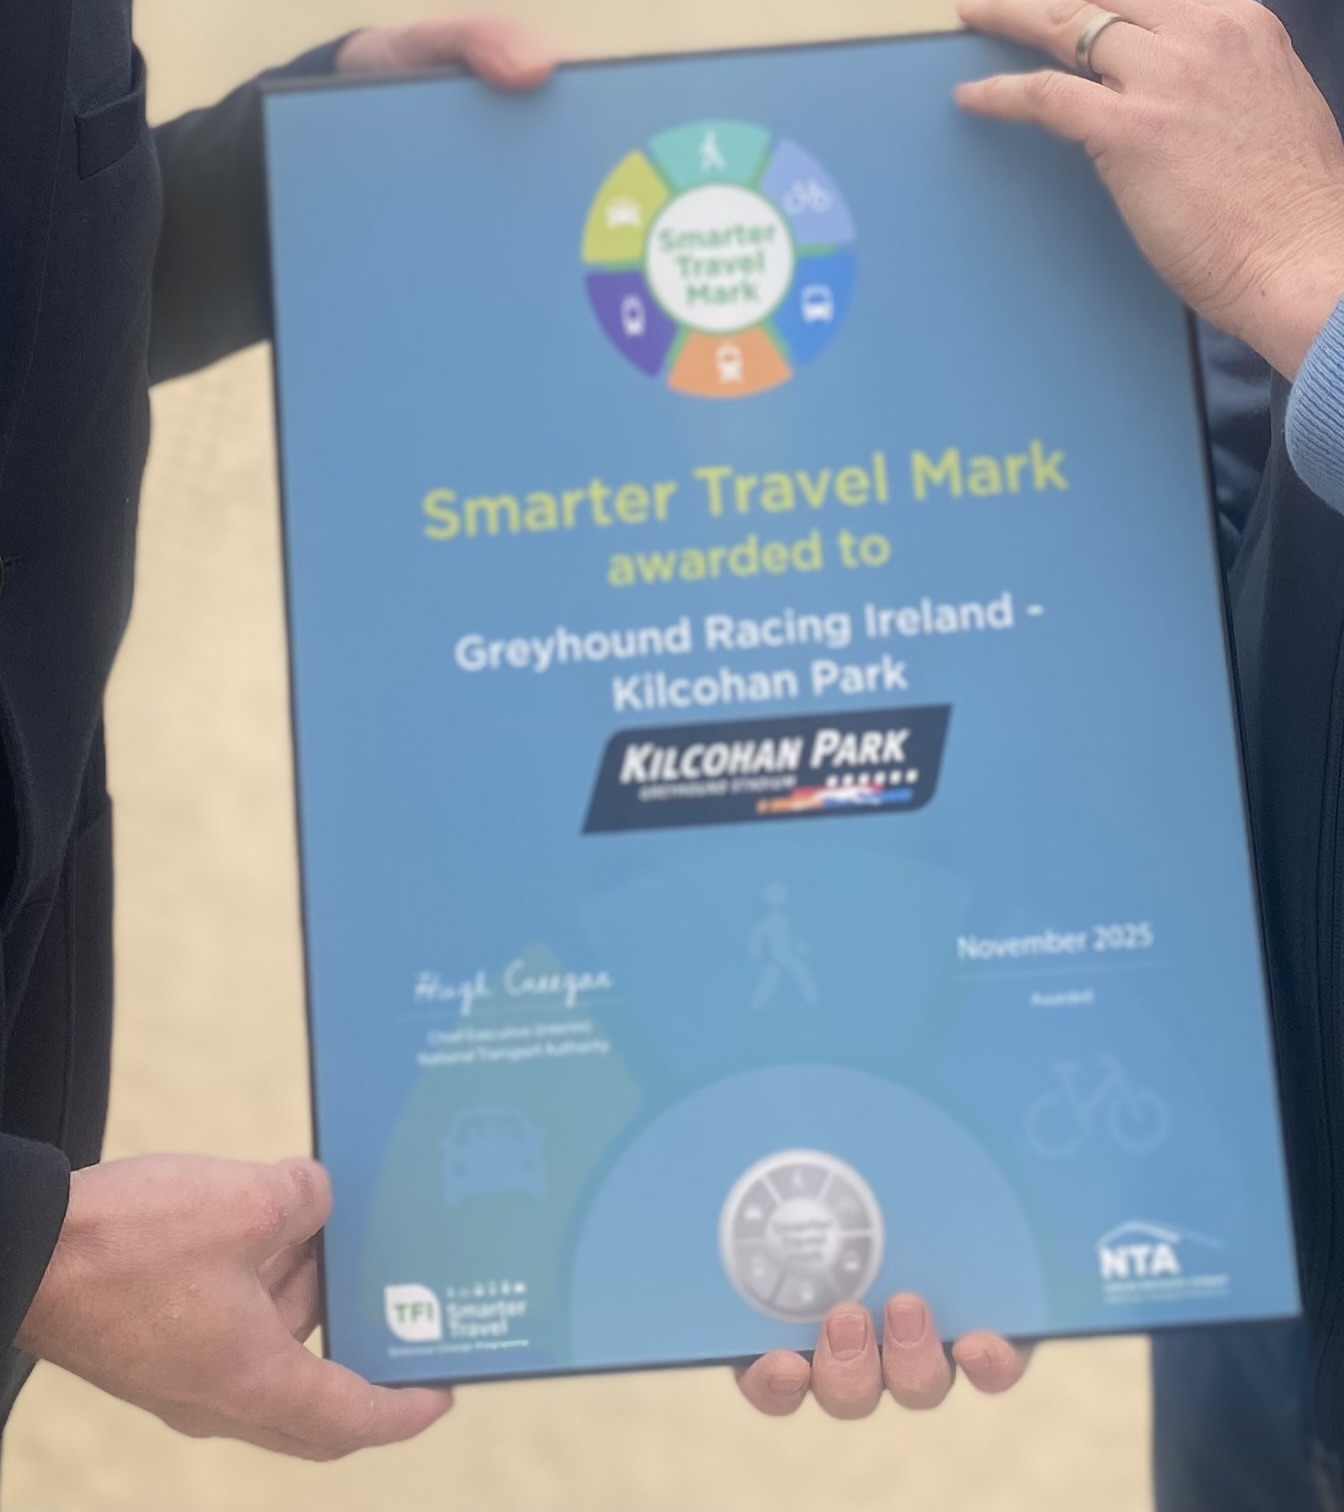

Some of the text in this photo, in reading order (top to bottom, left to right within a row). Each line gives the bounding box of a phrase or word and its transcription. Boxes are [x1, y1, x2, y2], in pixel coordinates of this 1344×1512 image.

[659, 223, 776, 254] Smarter
[676, 252, 766, 281] Travel
[686, 281, 759, 307] Mark
[422, 439, 1069, 541] Smarter Travel Mark
[607, 529, 891, 587] awarded to
[454, 617, 692, 673] Greyhound
[704, 607, 852, 650] Racing
[864, 592, 1015, 639] Ireland
[612, 655, 909, 713] Kilcohan Park
[618, 729, 911, 785] KILCOHAN PARK
[957, 921, 1155, 960] November 2025
[1099, 1243, 1181, 1279] NTA
[393, 1302, 435, 1324] TFI
[446, 1299, 527, 1321] Smarter
[447, 1317, 510, 1339] Travel
